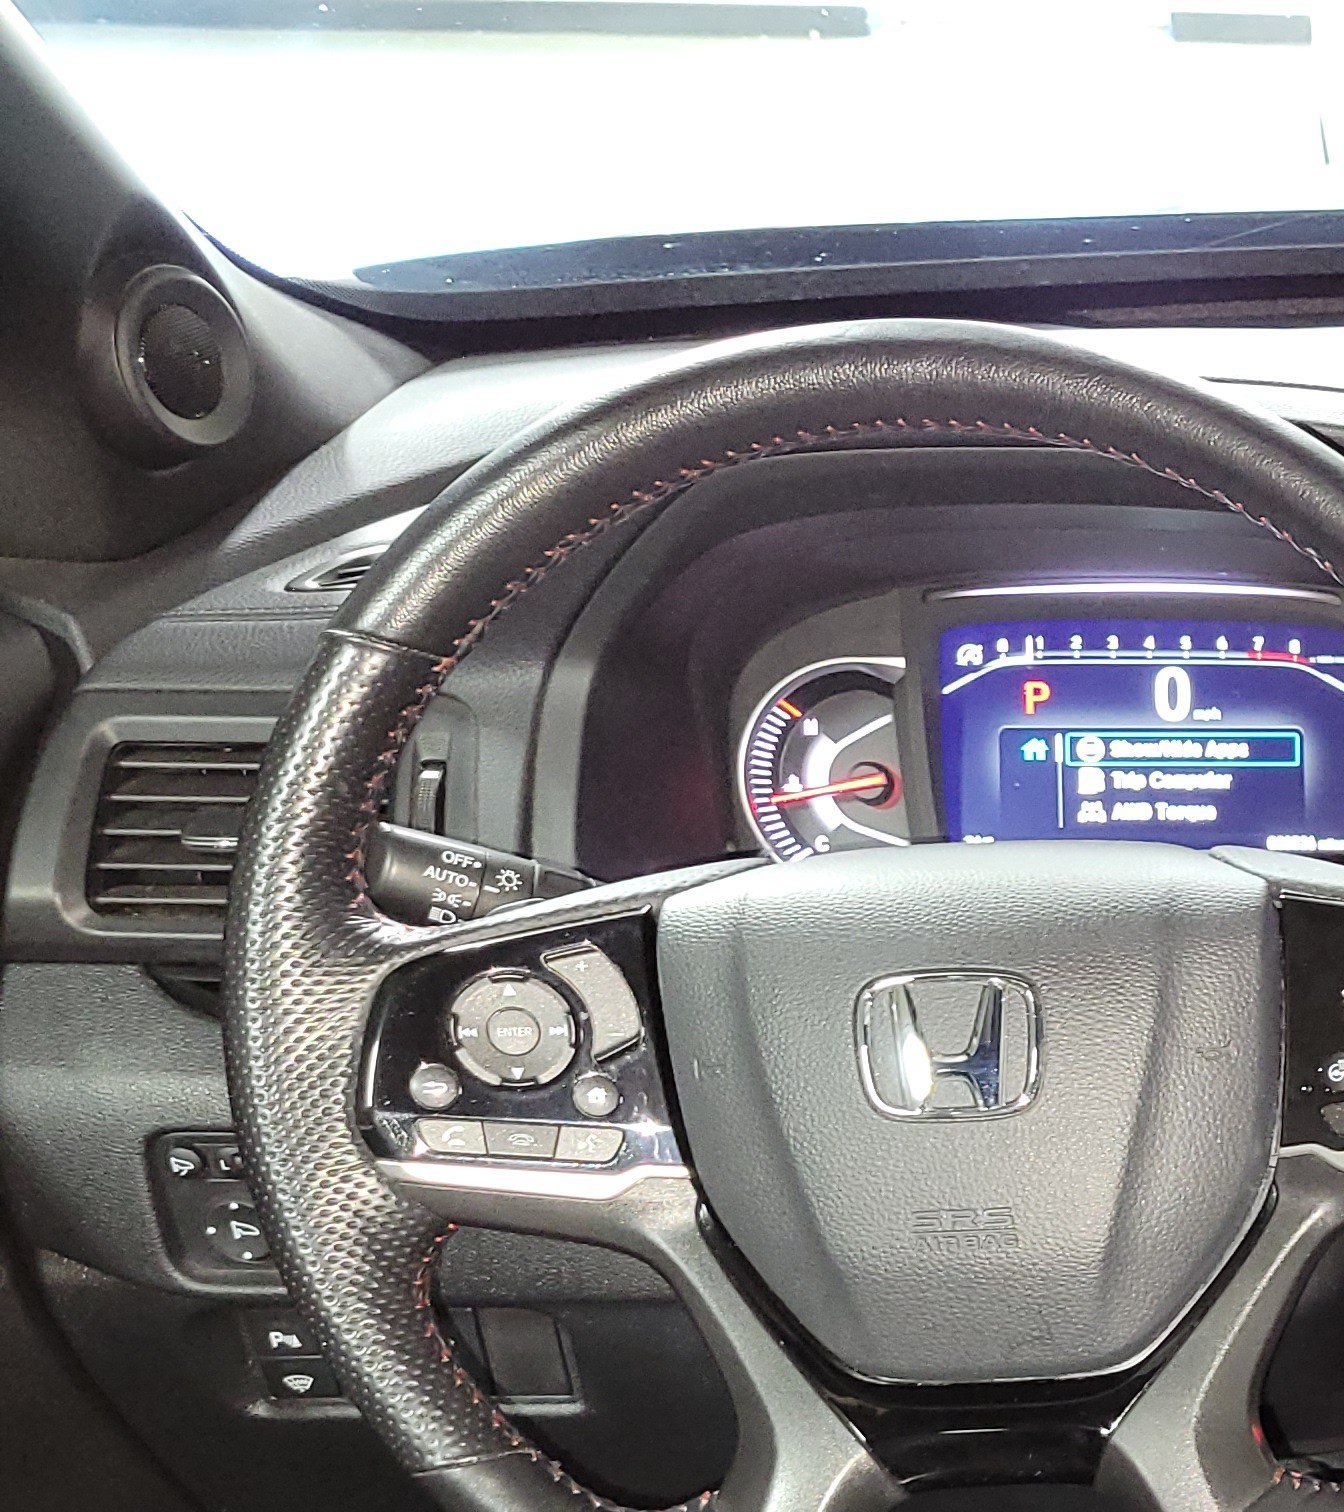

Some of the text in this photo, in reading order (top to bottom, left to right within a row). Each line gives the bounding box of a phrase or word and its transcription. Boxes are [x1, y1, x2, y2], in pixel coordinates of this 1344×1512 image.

[1069, 635, 1083, 650] 2
[1106, 635, 1120, 650] 3
[1142, 635, 1156, 650] 4
[1215, 635, 1229, 650] 6
[1252, 635, 1265, 650] 7
[1023, 680, 1050, 715] P
[1153, 665, 1192, 722] 0
[441, 850, 475, 868] OFF
[422, 865, 471, 888] AUTO
[496, 1026, 533, 1038] ENTER
[911, 1206, 1015, 1230] SRS
